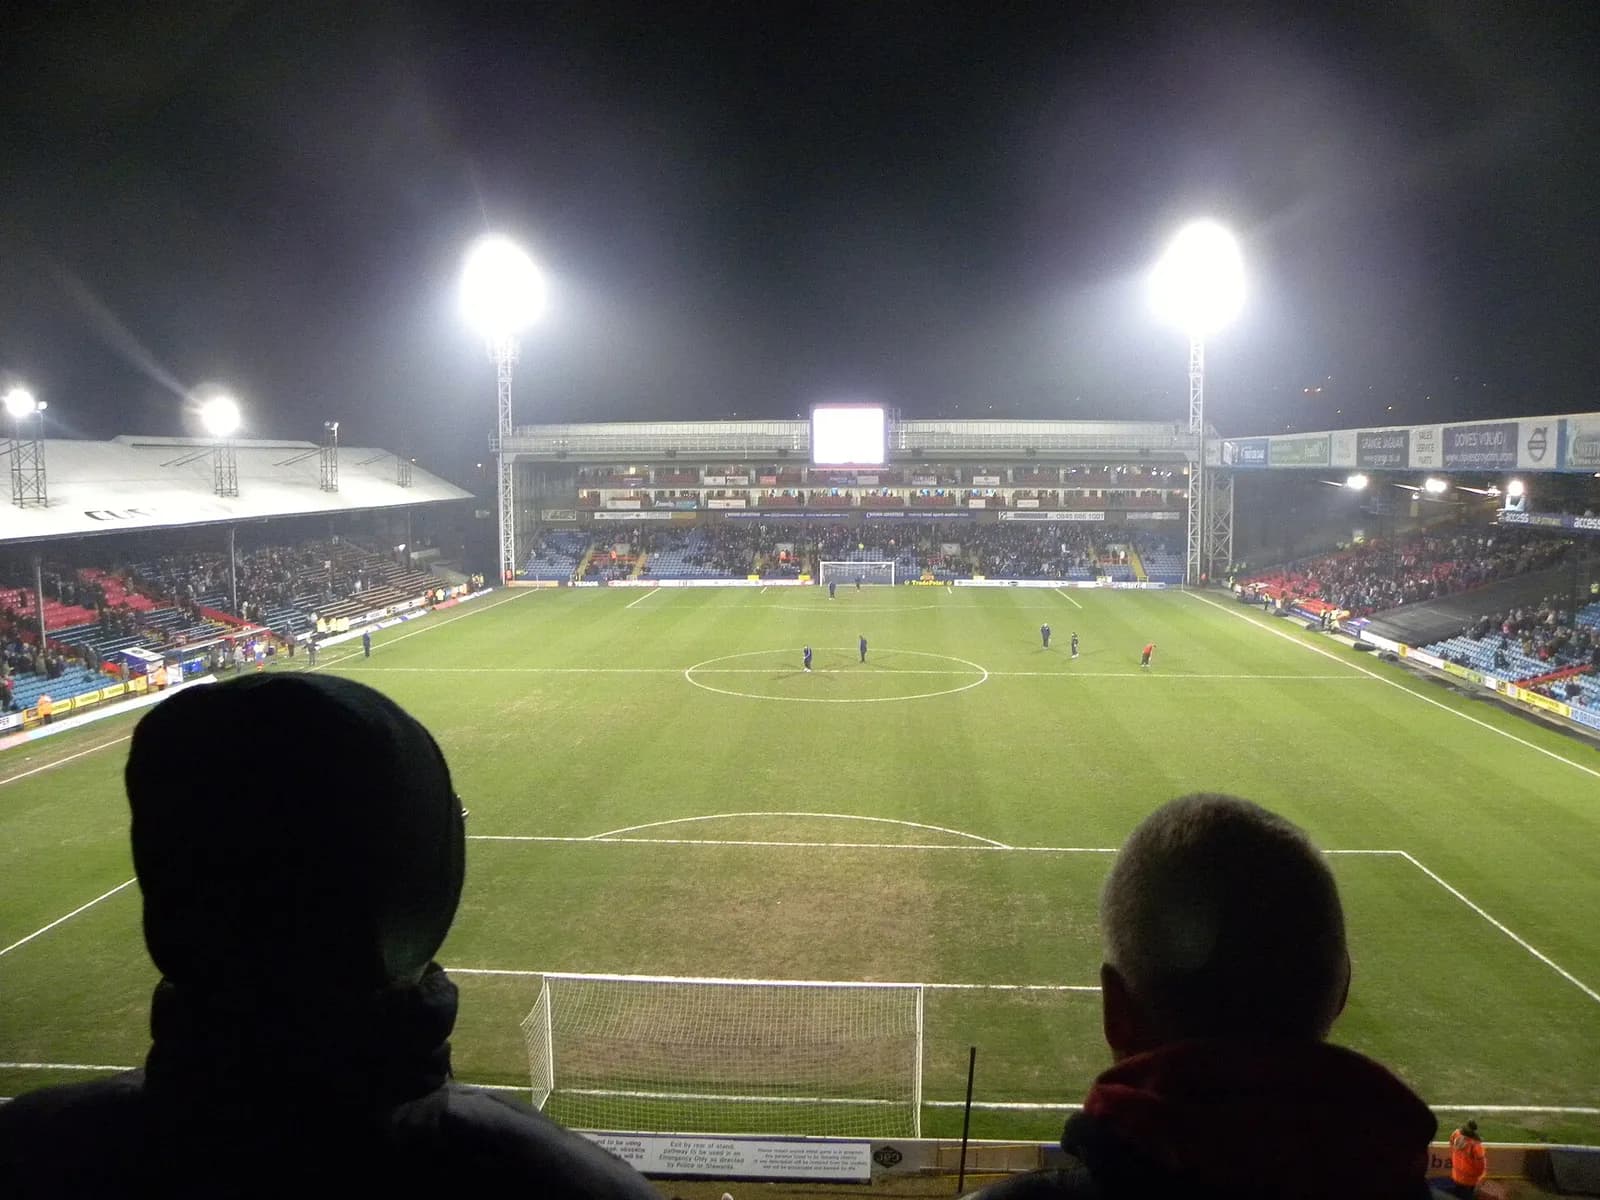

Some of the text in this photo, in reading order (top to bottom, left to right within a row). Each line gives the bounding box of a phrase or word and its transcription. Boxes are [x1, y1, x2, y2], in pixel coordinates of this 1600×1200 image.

[1418, 431, 1433, 440] SALES
[1455, 431, 1503, 446] DOVES VOLVO
[1416, 443, 1434, 452] SERVICE
[1418, 456, 1432, 464] PARTS
[1506, 513, 1528, 523] access
